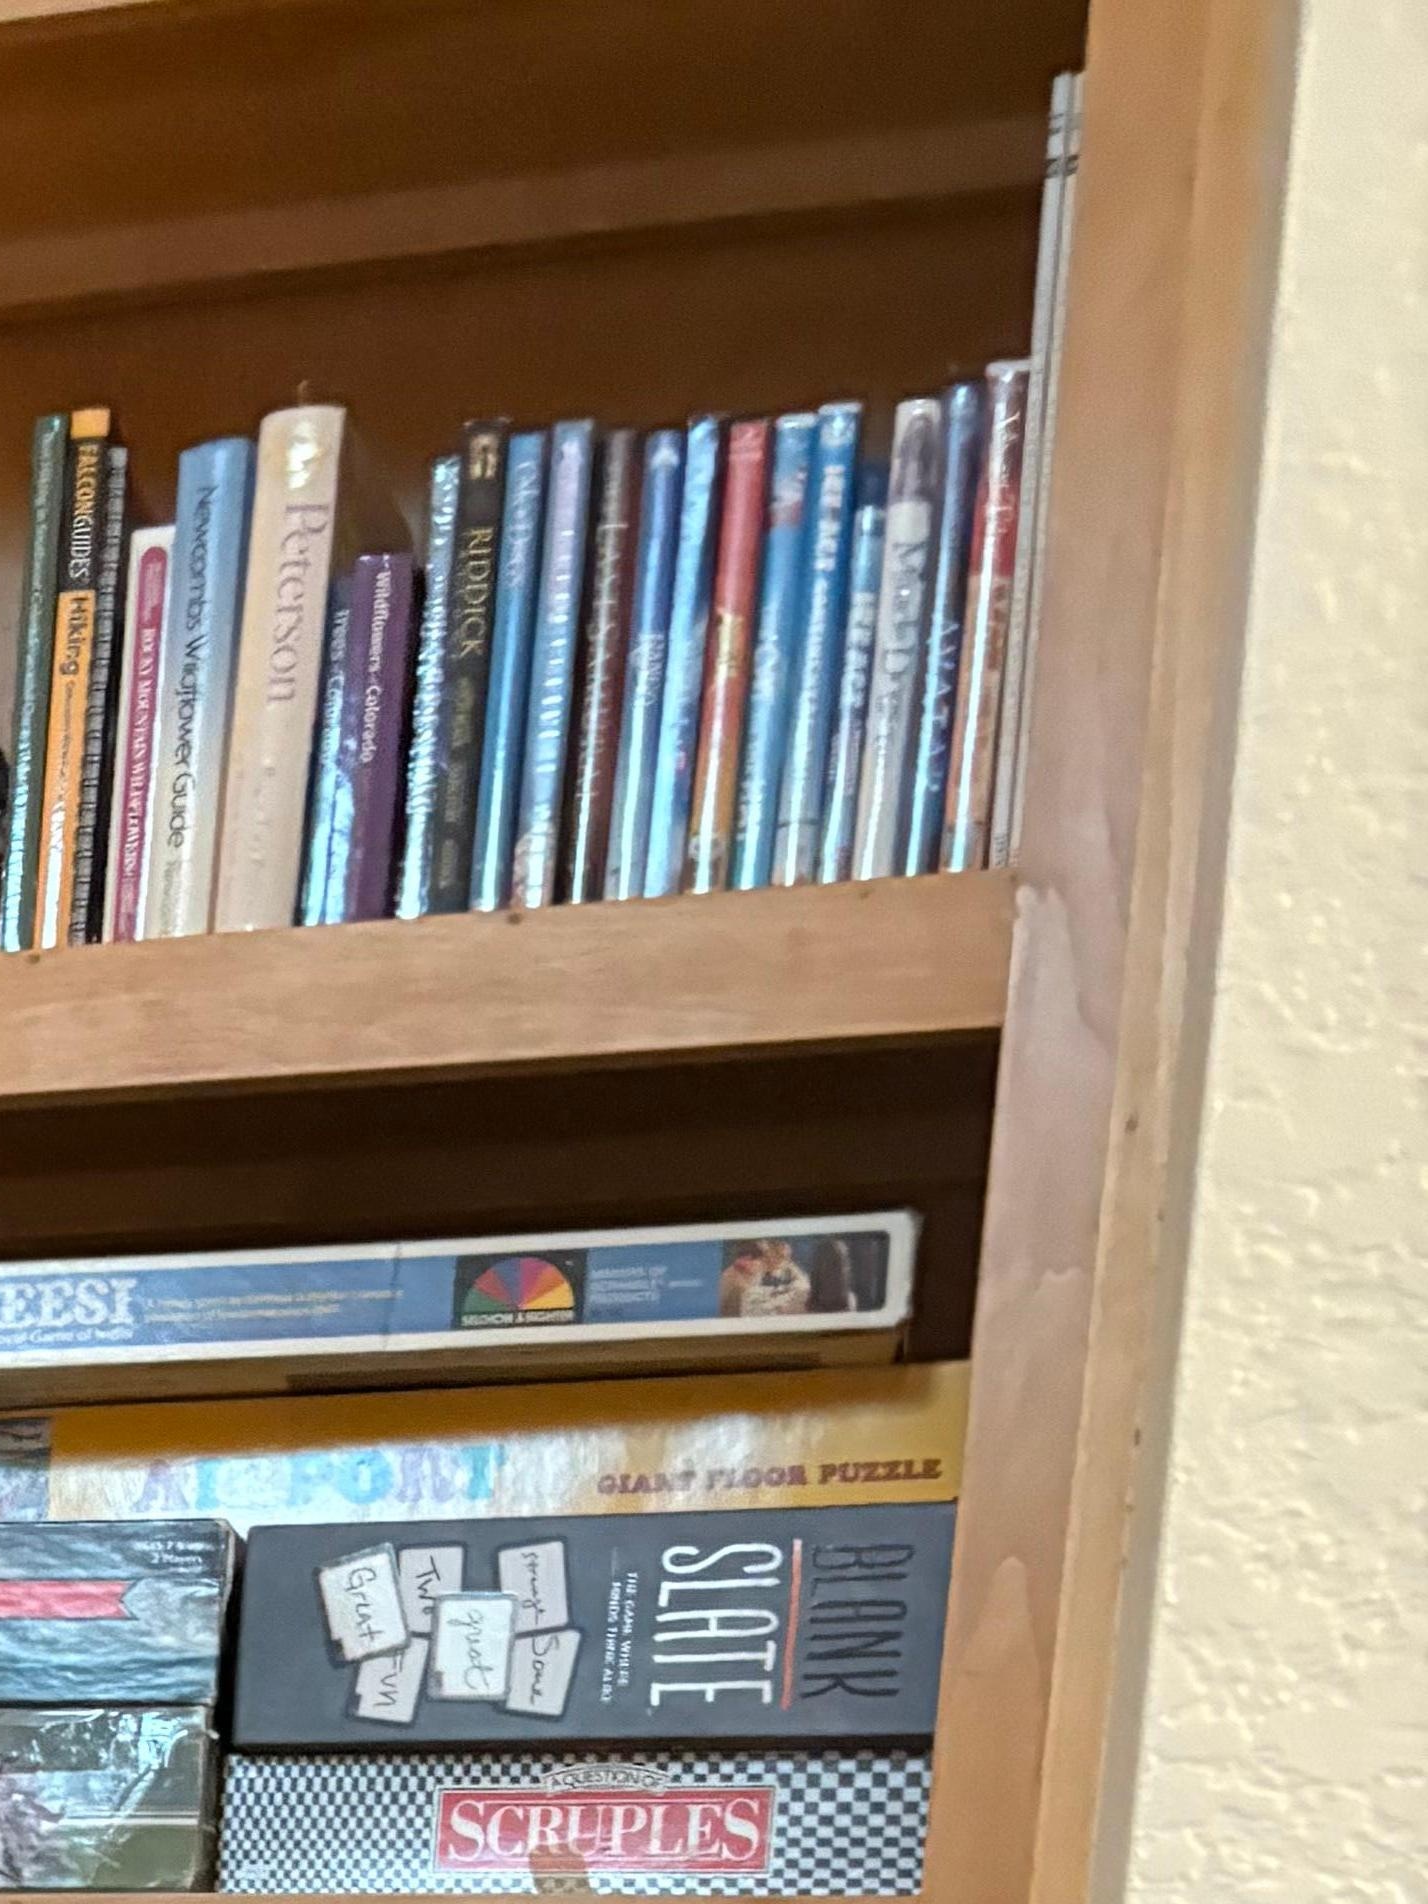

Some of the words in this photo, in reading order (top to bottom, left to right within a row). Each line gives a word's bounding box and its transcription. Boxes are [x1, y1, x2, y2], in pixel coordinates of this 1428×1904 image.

[60, 596, 90, 674] Hiking
[266, 502, 330, 702] Peterson
[459, 527, 494, 659] RIDDICK
[165, 771, 196, 849] Guide
[596, 1471, 696, 1495] GIANT
[706, 1465, 809, 1491] FLOOR
[819, 1459, 943, 1484] PUZZLE
[649, 1542, 784, 1708] SLATE
[798, 1543, 915, 1700] BLANK
[448, 1801, 762, 1864] SCRUPLES
